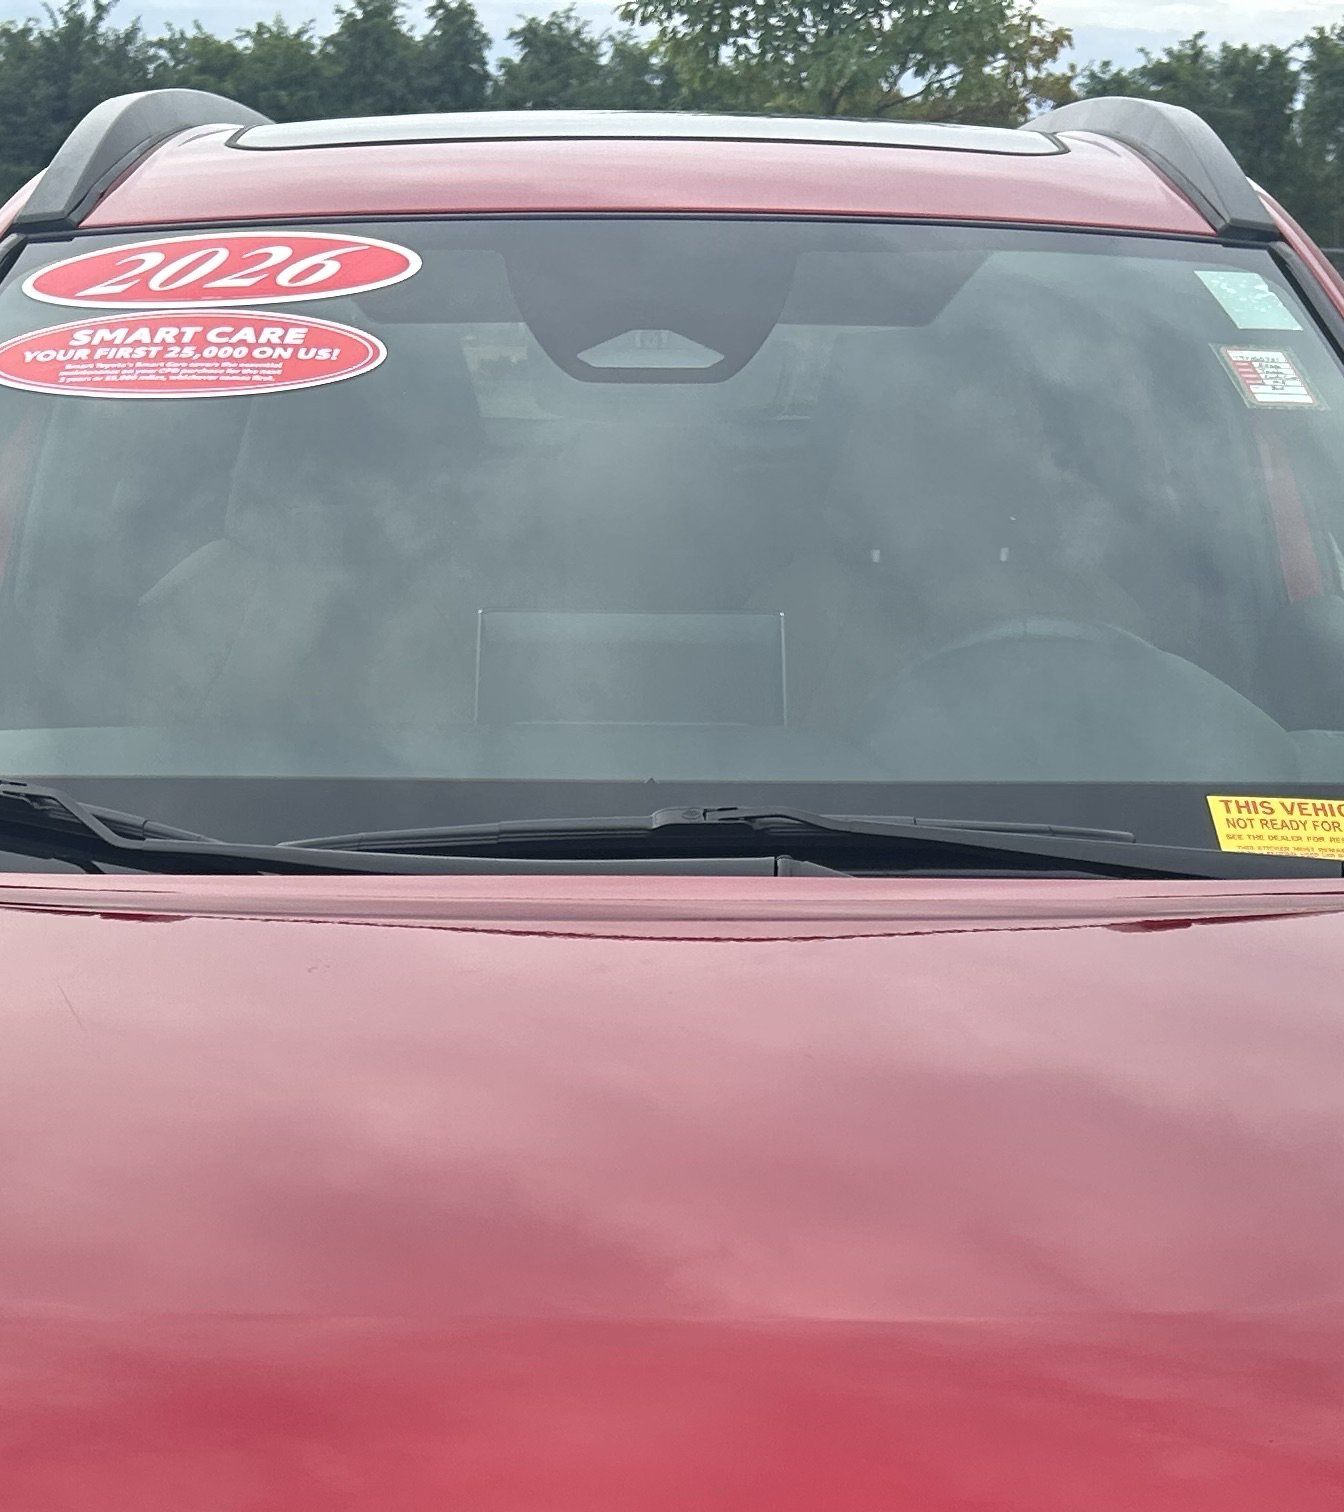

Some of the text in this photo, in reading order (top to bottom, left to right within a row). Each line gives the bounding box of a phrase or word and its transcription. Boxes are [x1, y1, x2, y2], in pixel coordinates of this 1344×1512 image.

[74, 245, 370, 296] 2026
[69, 327, 309, 346] SMART CARE
[24, 346, 340, 363] YOUR FIRST 25,000 ON US!
[1218, 799, 1275, 815] THIS
[1226, 818, 1255, 829] NOT
[1260, 819, 1307, 831] READY
[1312, 821, 1342, 833] FOR
